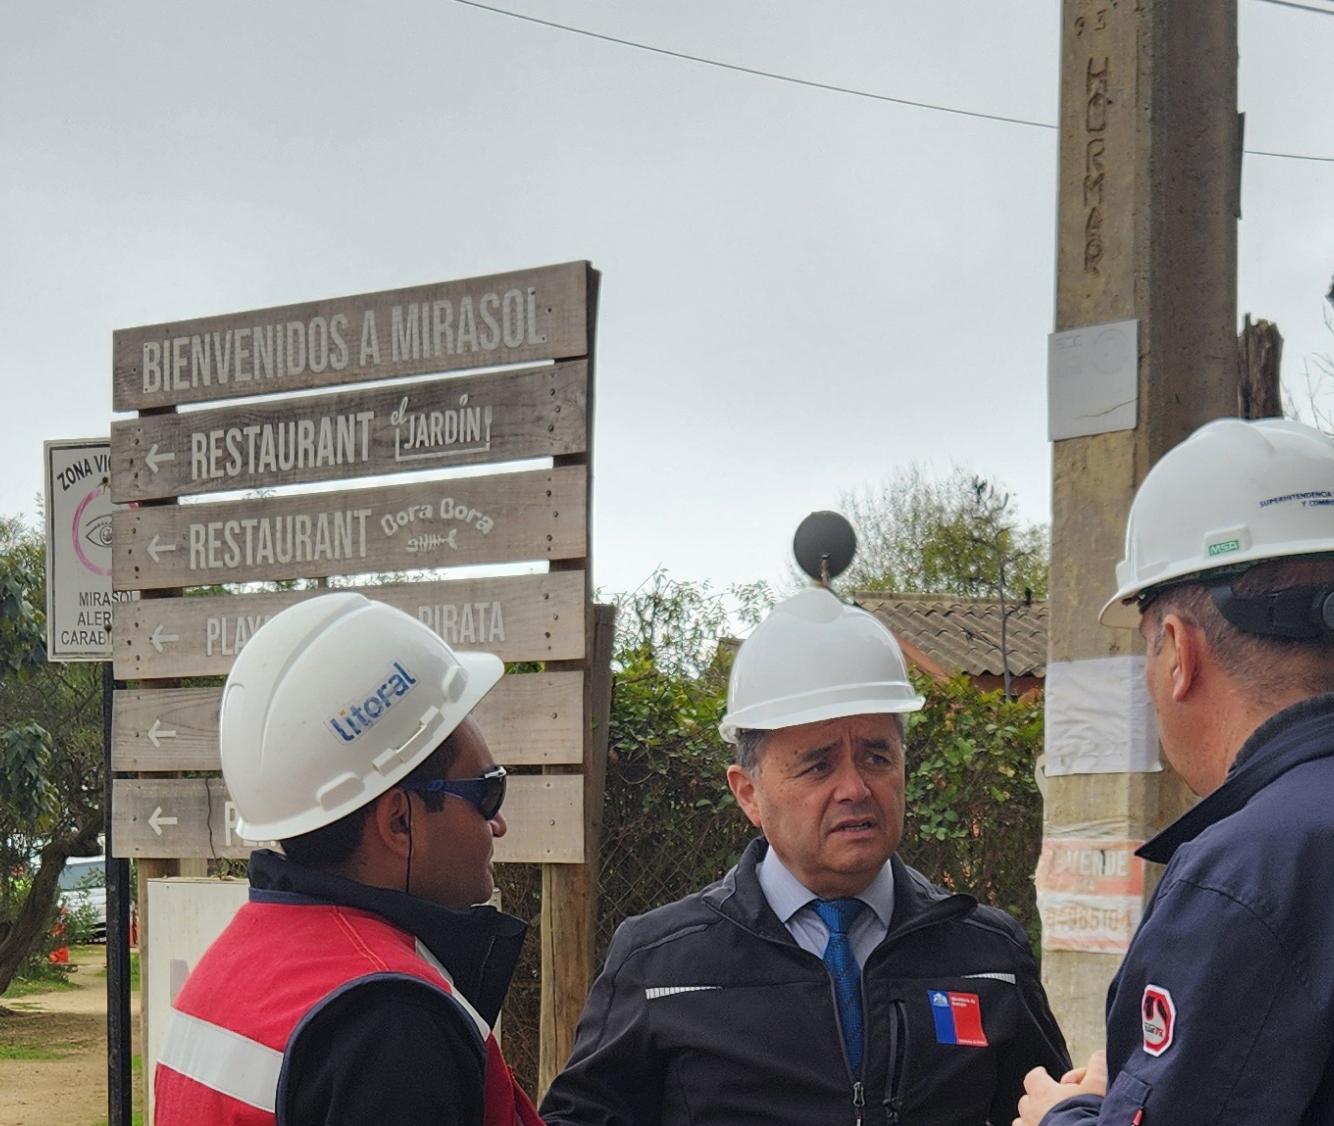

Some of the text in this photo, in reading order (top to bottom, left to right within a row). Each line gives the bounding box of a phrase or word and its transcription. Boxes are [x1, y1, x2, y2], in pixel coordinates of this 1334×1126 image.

[143, 286, 548, 394] BIENVENIDOS A MIRASOL
[191, 410, 375, 480] RESTAURANT
[390, 396, 409, 426] el
[57, 458, 93, 491] ZONA
[190, 497, 495, 569] RESTAURANT Bora Bora
[1210, 541, 1238, 554] MSA
[77, 611, 111, 626] ALER
[207, 616, 271, 656] PLAY
[61, 630, 112, 645] CARAB
